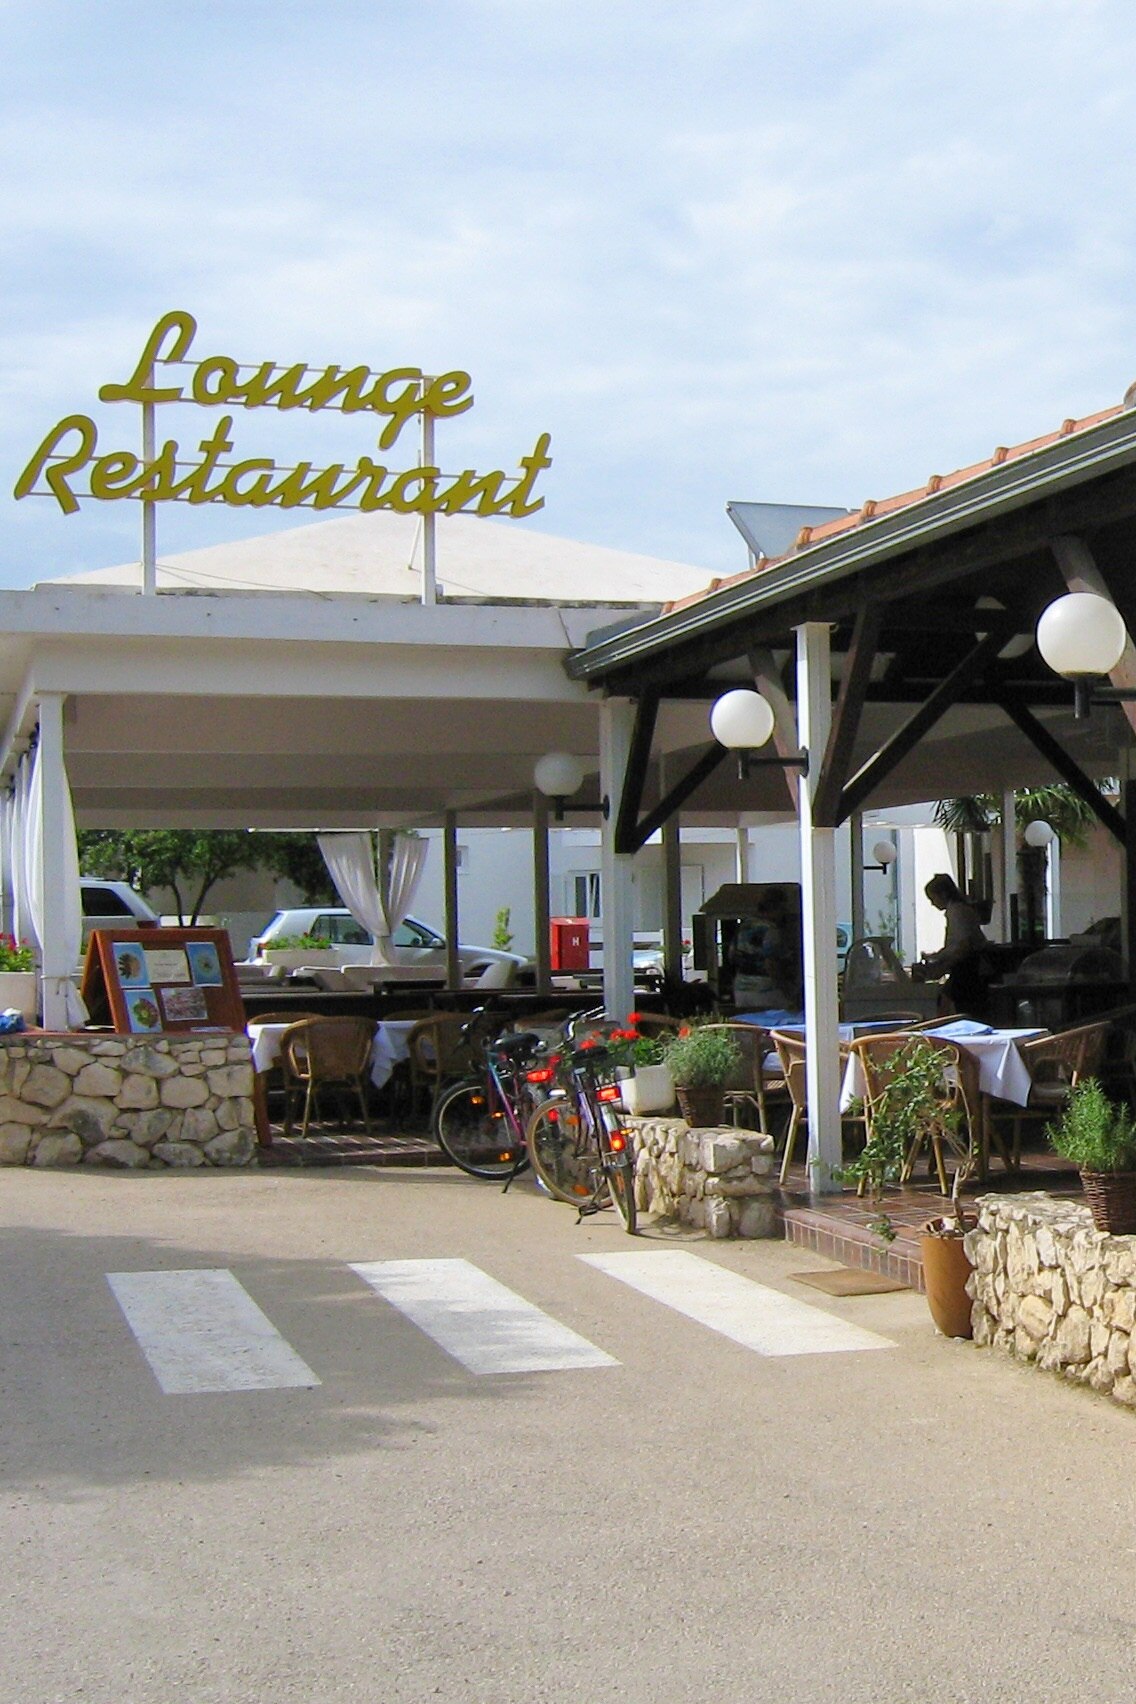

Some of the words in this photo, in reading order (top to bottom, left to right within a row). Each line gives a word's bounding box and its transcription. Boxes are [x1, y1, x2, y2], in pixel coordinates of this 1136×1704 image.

[99, 310, 474, 450] Lounge
[14, 414, 553, 518] Restaurant
[572, 936, 580, 947] H
